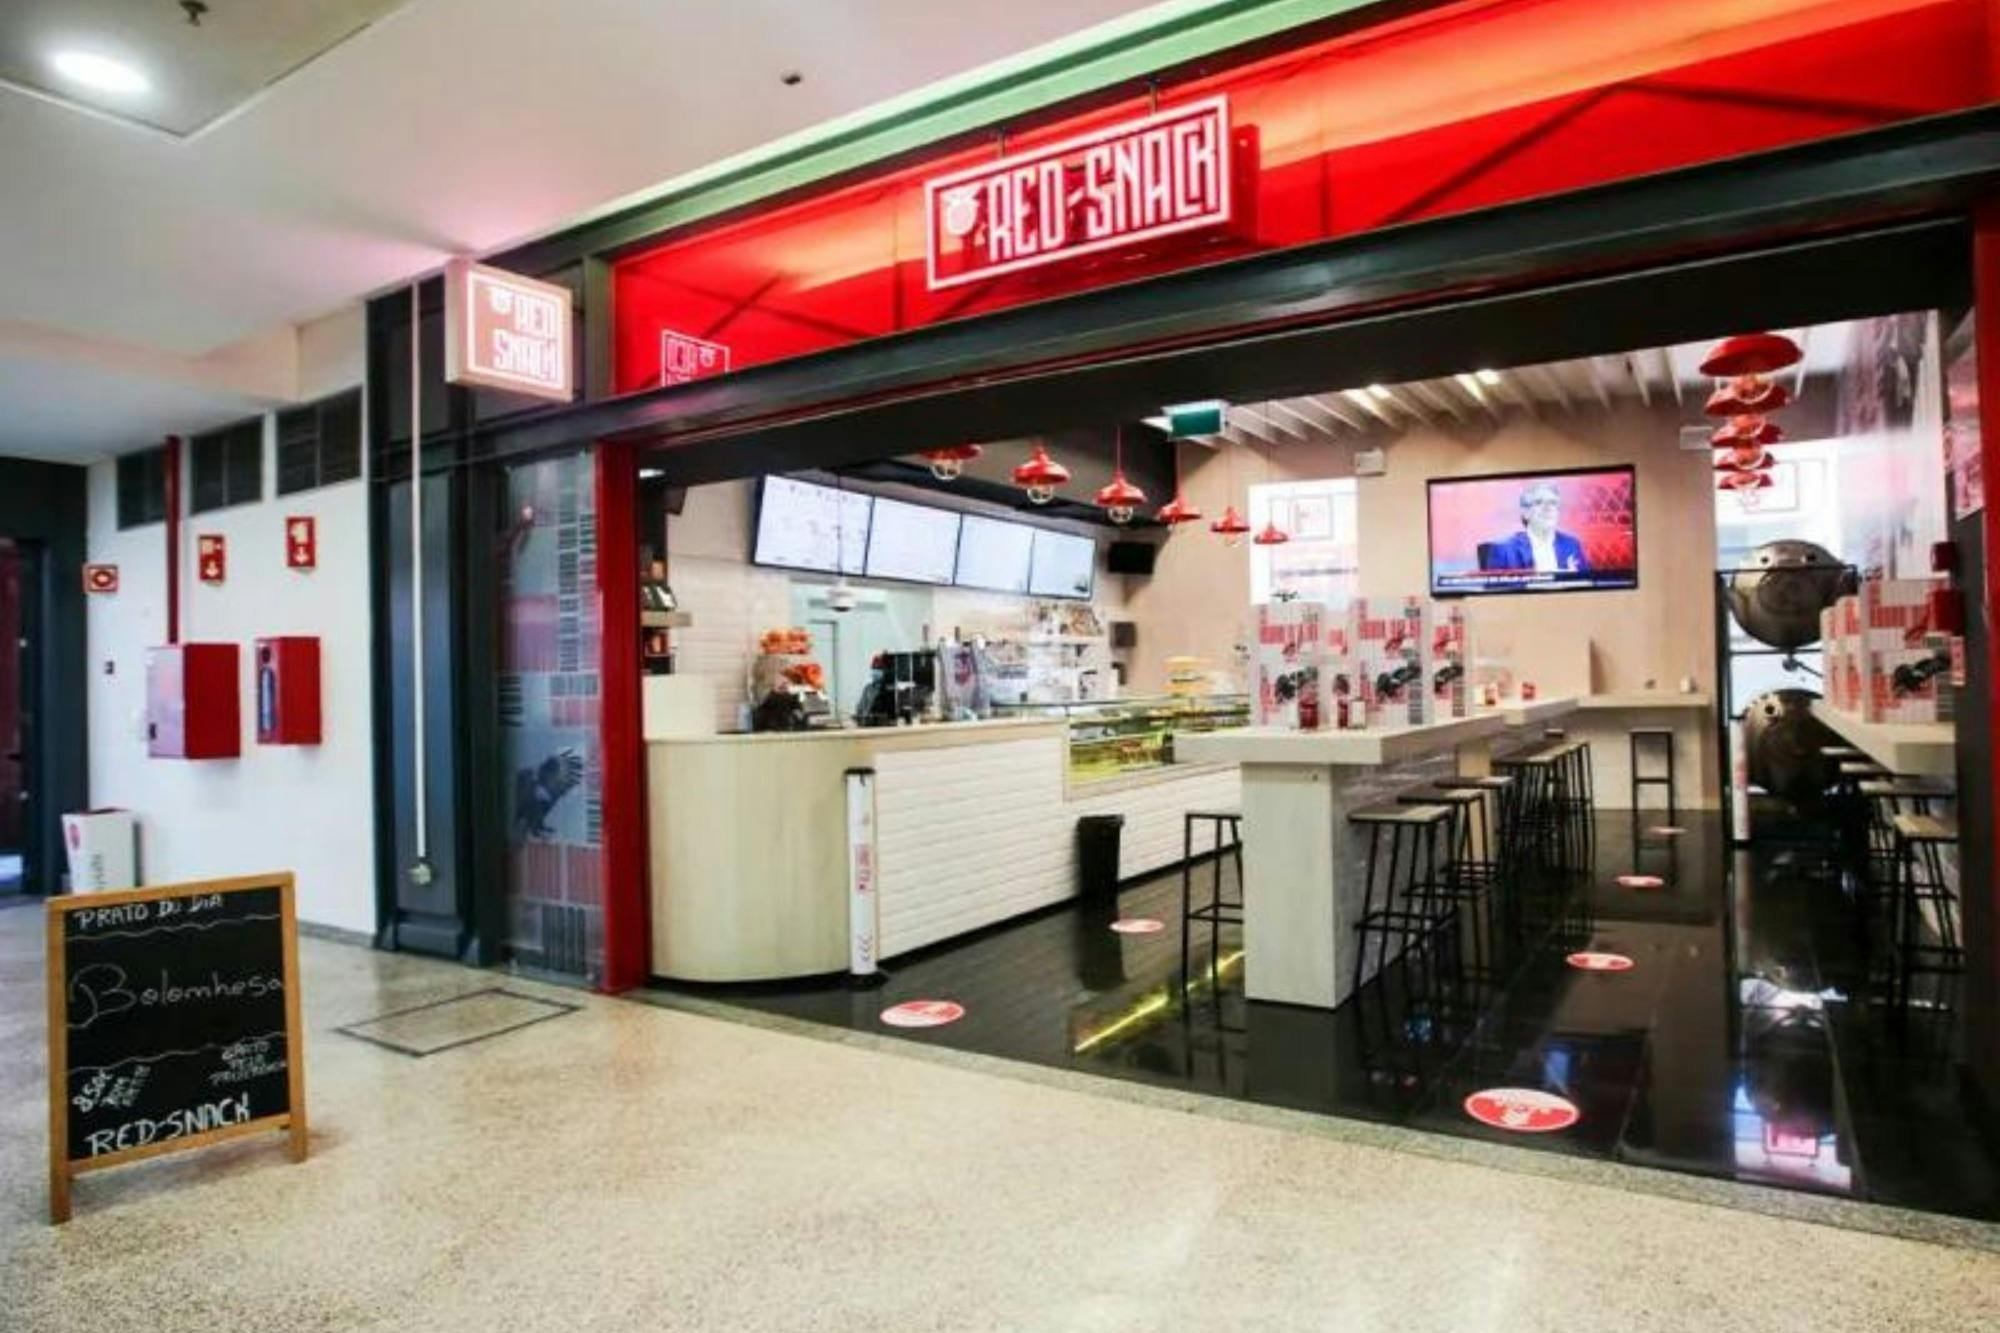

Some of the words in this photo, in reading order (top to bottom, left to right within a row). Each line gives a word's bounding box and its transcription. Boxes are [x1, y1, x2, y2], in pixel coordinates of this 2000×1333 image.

[988, 113, 1217, 261] RED-SNACK
[514, 295, 559, 338] RED
[493, 329, 559, 382] SNACK
[74, 904, 149, 929] PRATO
